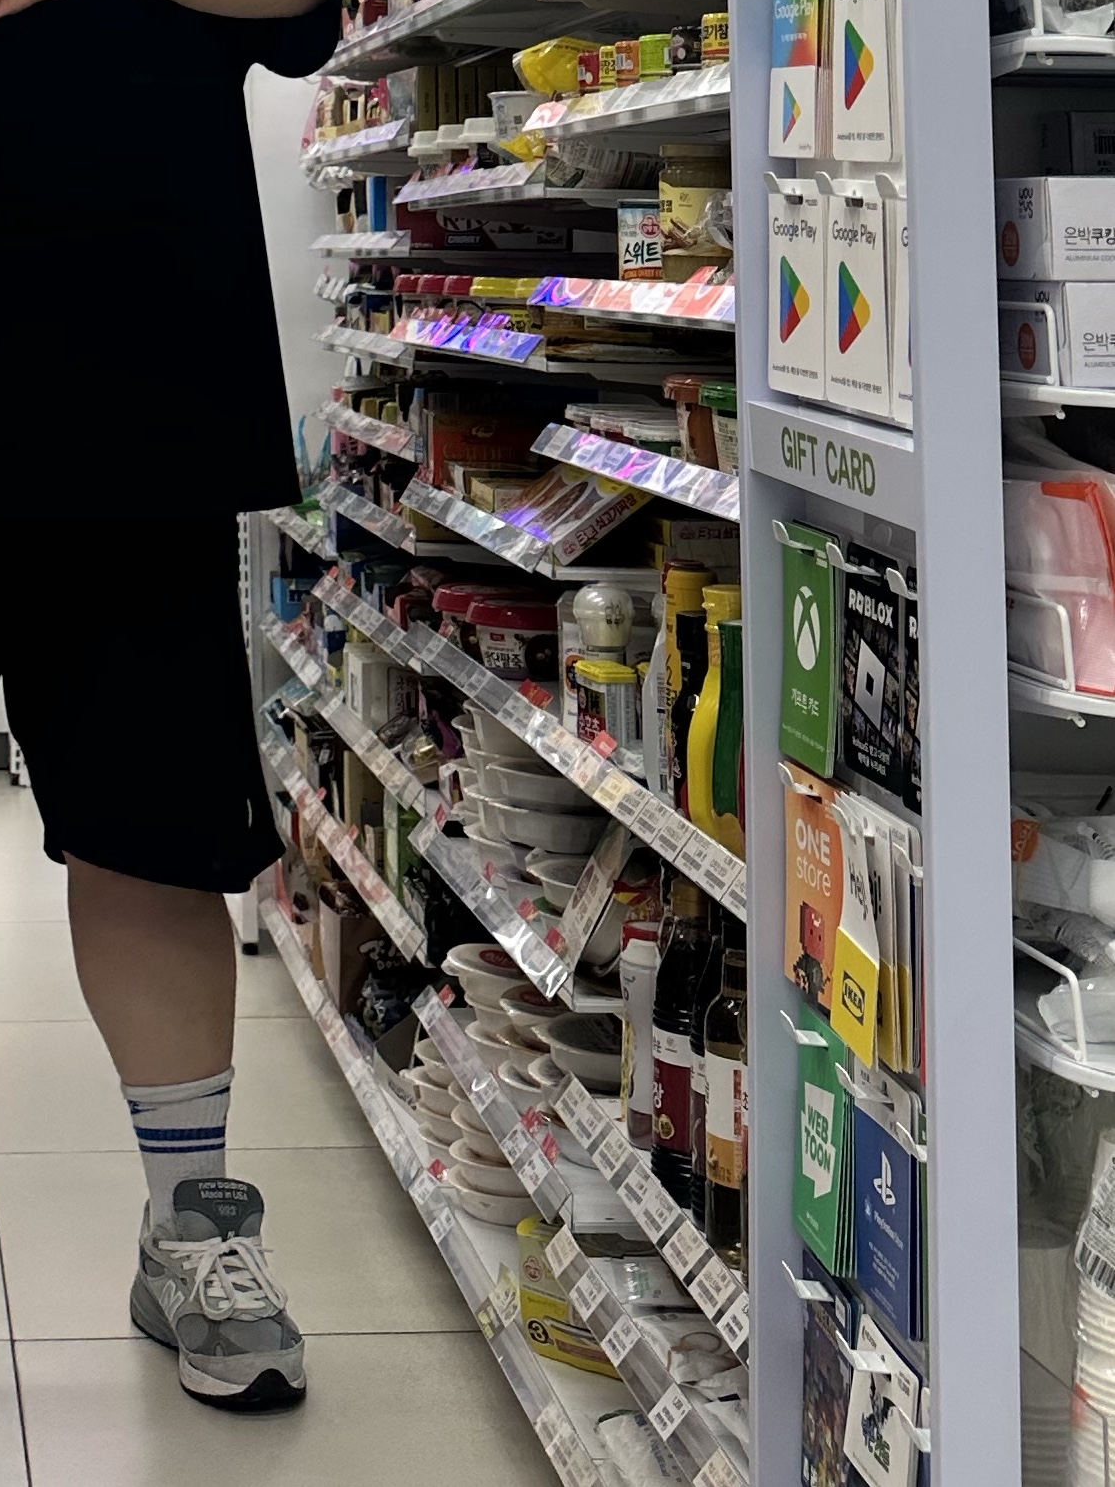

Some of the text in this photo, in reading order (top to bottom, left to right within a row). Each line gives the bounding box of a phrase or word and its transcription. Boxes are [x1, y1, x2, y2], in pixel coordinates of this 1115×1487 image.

[773, 217, 816, 244] Google Play
[832, 220, 876, 250] Google Play
[623, 240, 661, 265] 스위트
[781, 426, 876, 497] GIFT CARD
[848, 587, 893, 629] ROBLOX
[795, 818, 831, 867] ONE
[796, 857, 831, 898] store
[844, 982, 864, 1015] IKEA
[808, 1104, 829, 1145] WEB
[805, 1126, 831, 1174] TOON
[198, 1182, 248, 1192] new balance
[201, 1190, 249, 1202] Made in USA
